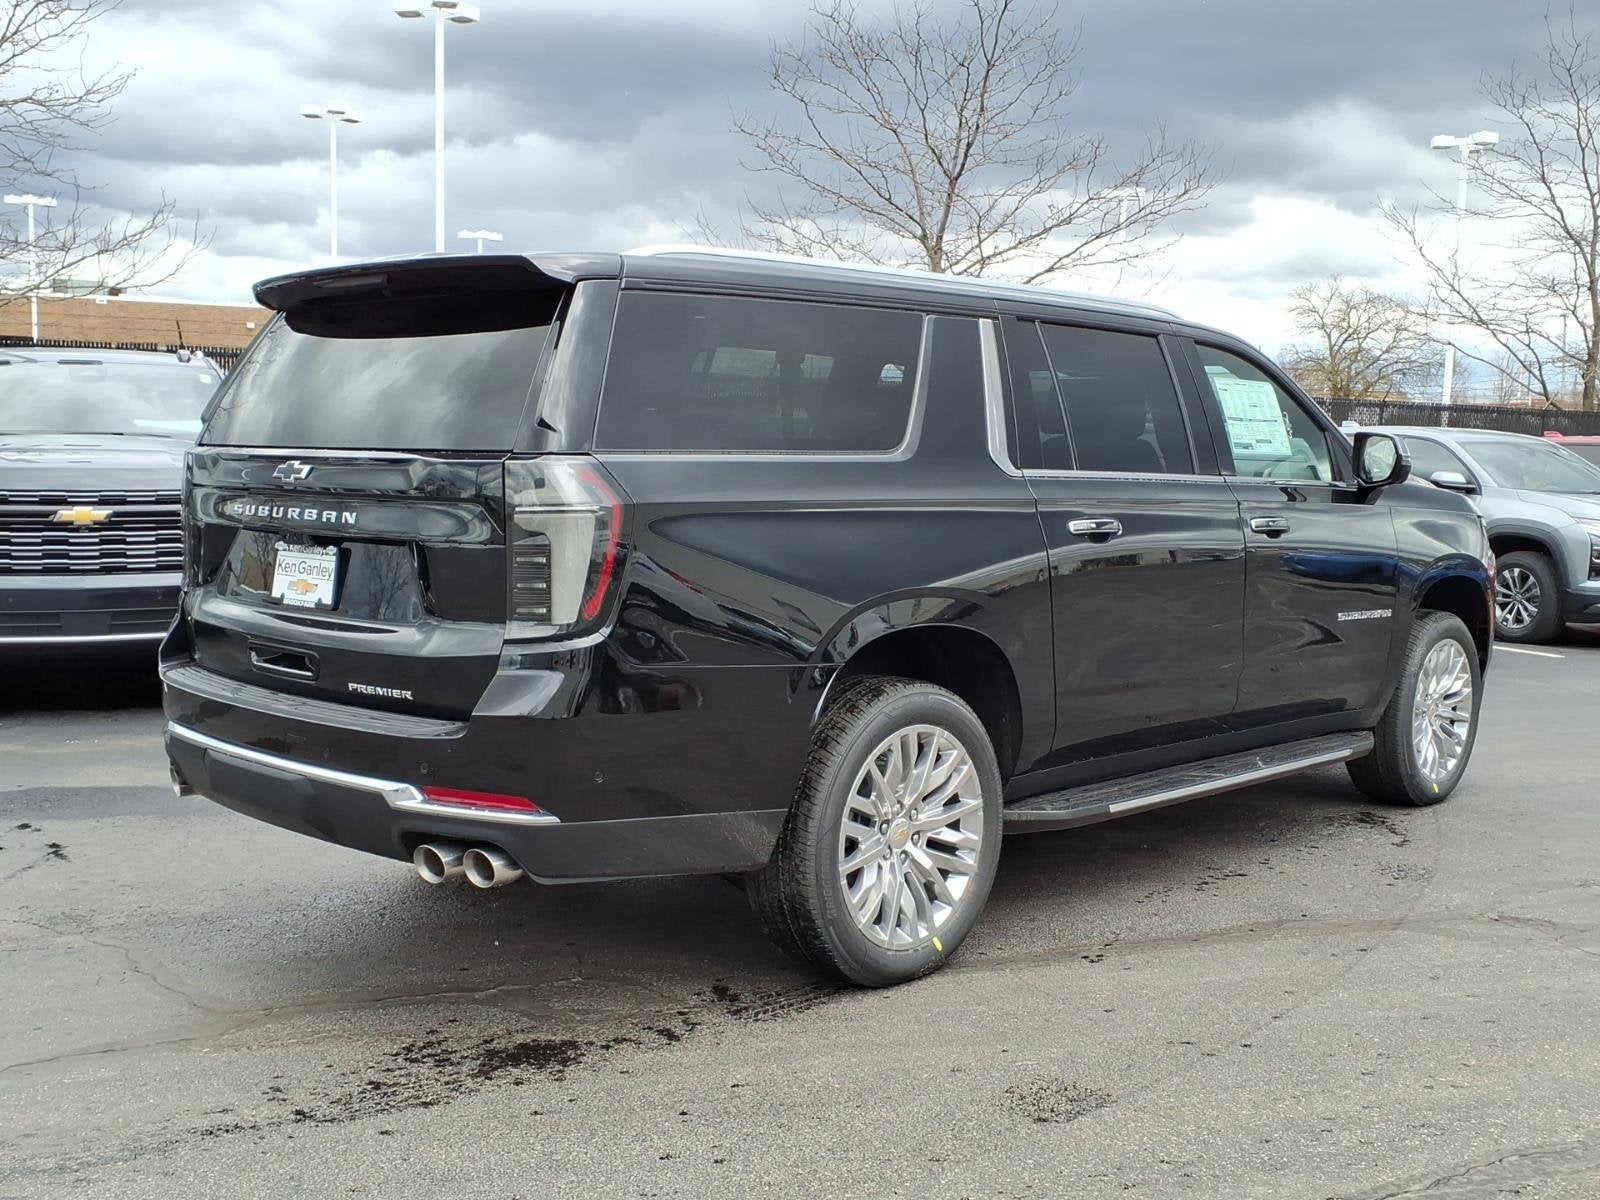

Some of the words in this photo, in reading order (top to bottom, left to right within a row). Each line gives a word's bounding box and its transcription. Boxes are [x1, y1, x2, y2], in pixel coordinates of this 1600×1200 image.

[233, 504, 357, 524] SUBURBAN
[289, 544, 302, 553] Ken
[303, 544, 323, 557] Ganley
[277, 557, 297, 573] Ken
[298, 560, 334, 580] Ganley
[1337, 608, 1392, 621] SUBURBAN
[347, 682, 413, 700] PREMIER
